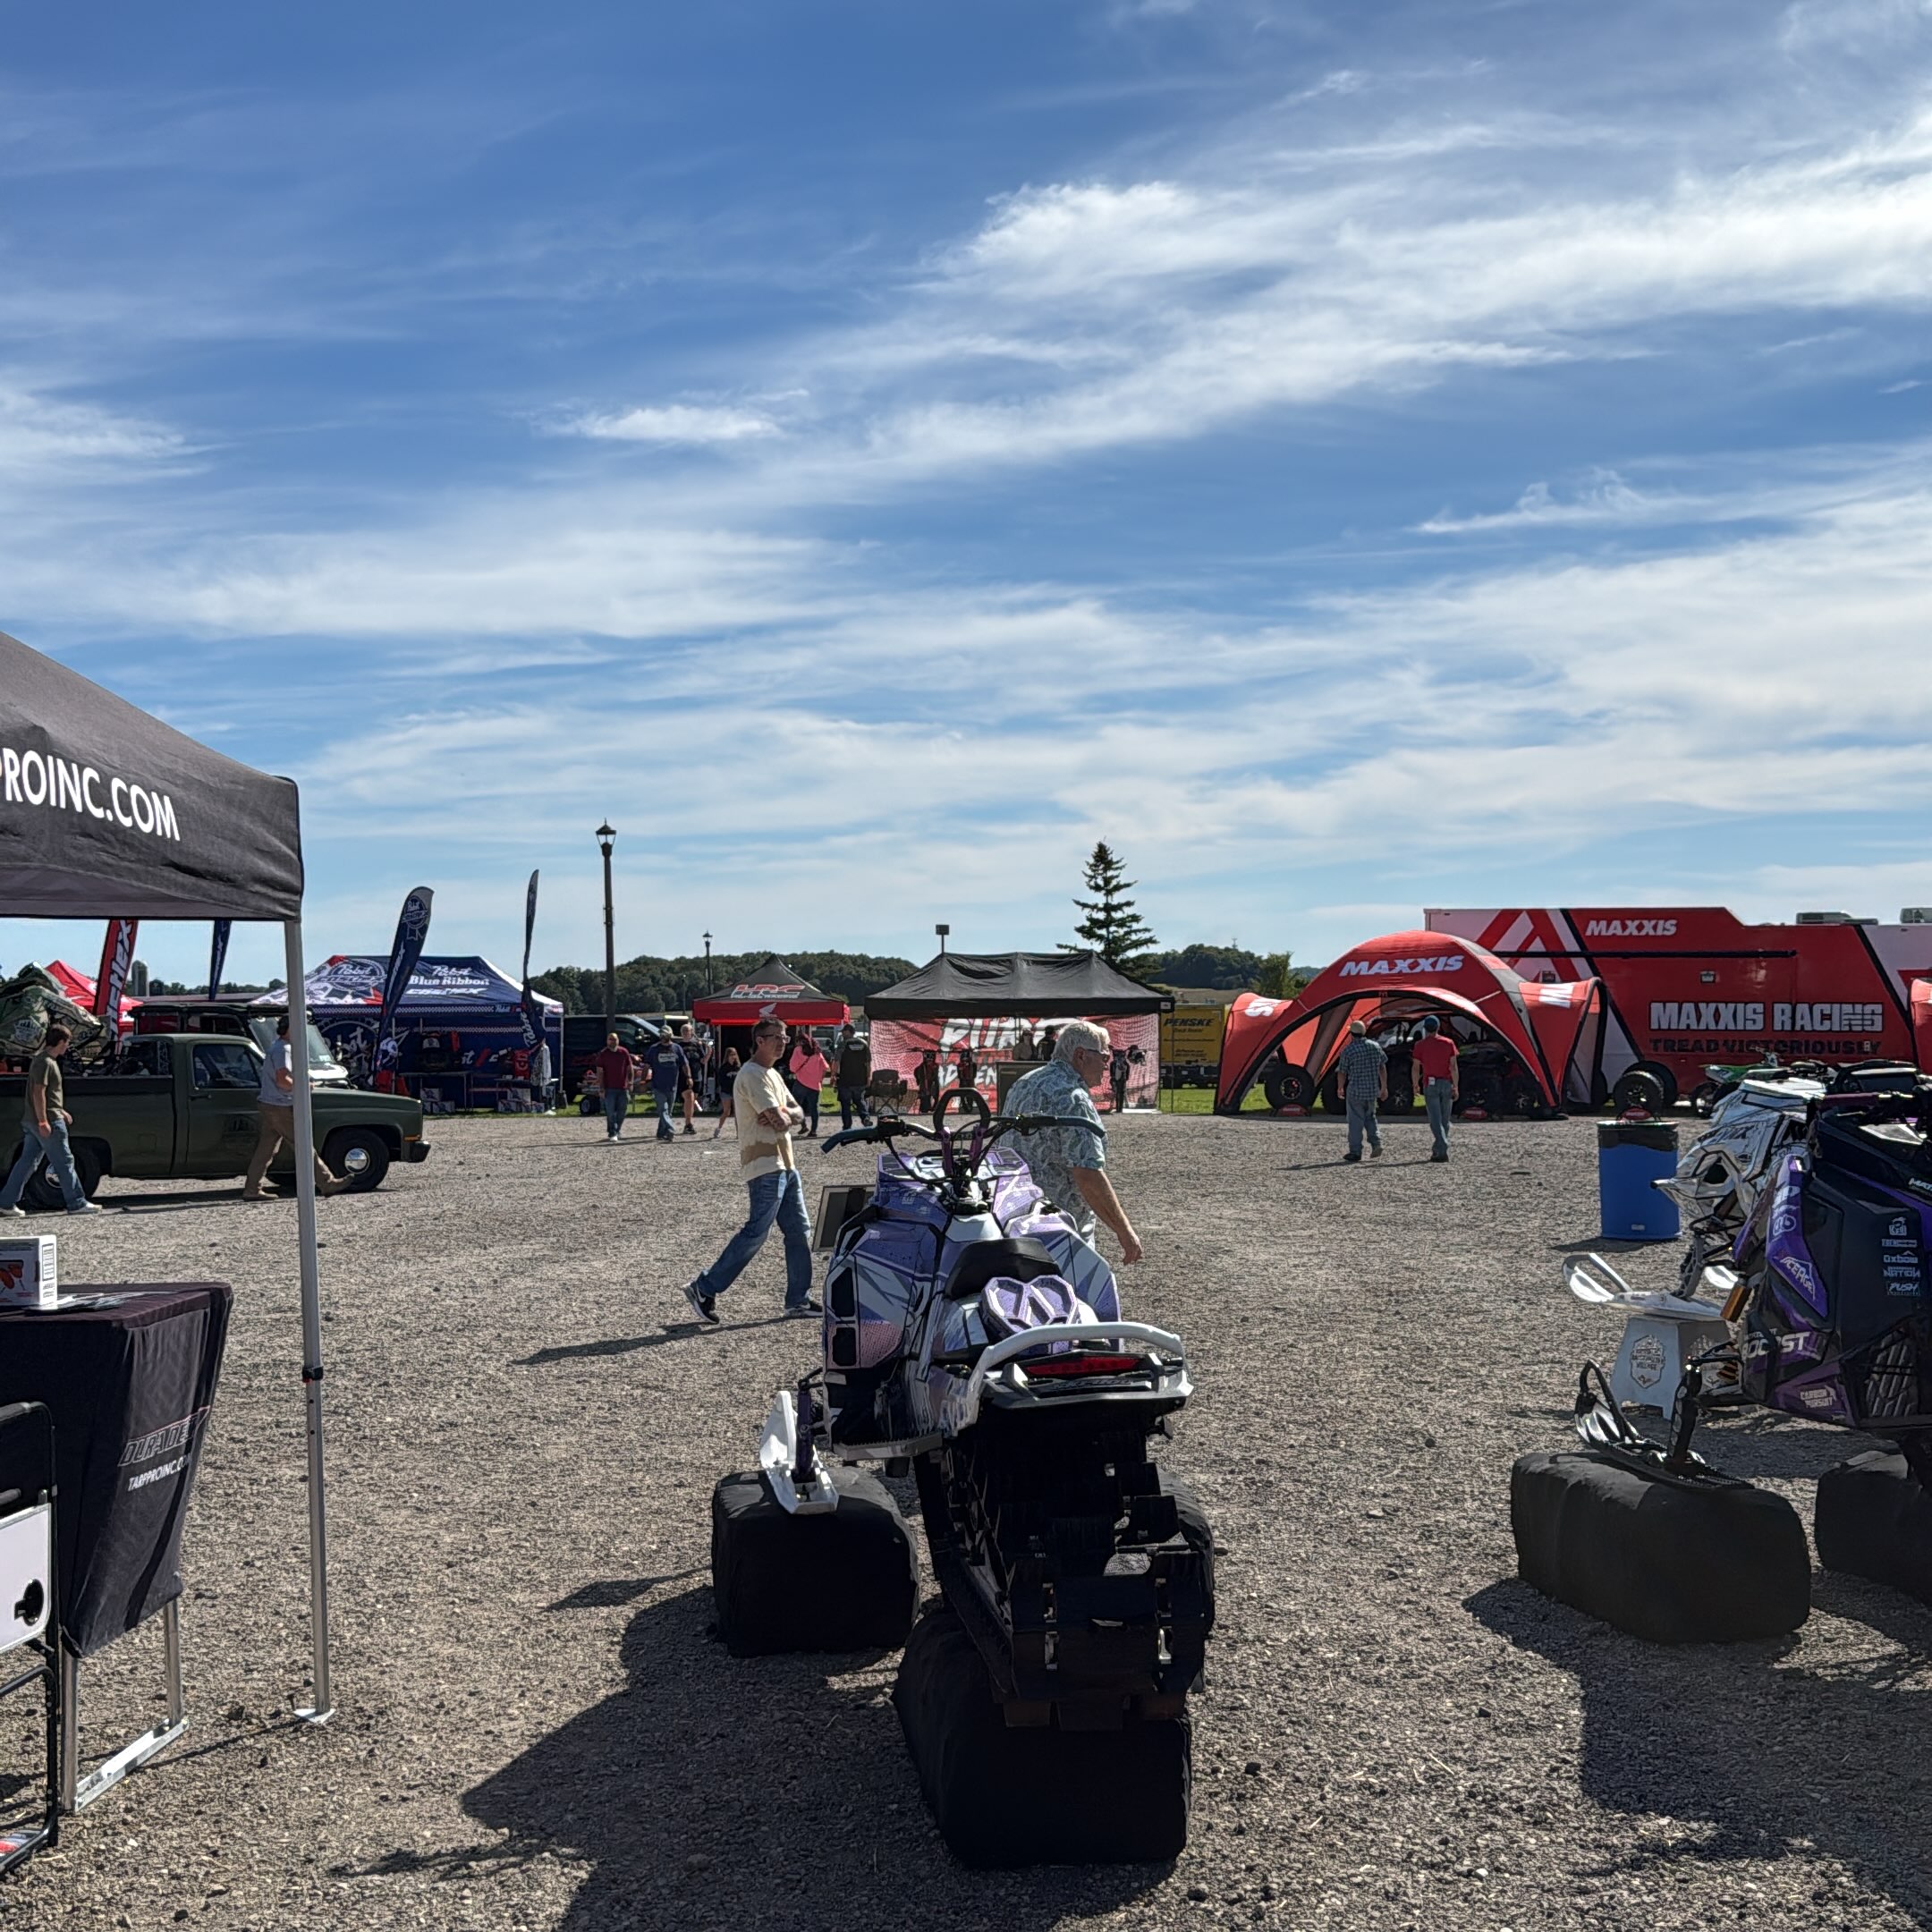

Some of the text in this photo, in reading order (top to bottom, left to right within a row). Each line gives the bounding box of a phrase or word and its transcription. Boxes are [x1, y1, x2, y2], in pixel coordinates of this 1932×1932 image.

[0, 748, 180, 841] ROINC.COM
[1585, 919, 1678, 936] MAXXIS
[1338, 955, 1464, 977] MAXXIS
[409, 975, 490, 986] Blue Ribbon
[731, 985, 805, 996] HRC
[1164, 1018, 1215, 1027] PENSKE
[1650, 1003, 1764, 1030] MAXXIS
[1650, 1038, 1719, 1053] TREAD
